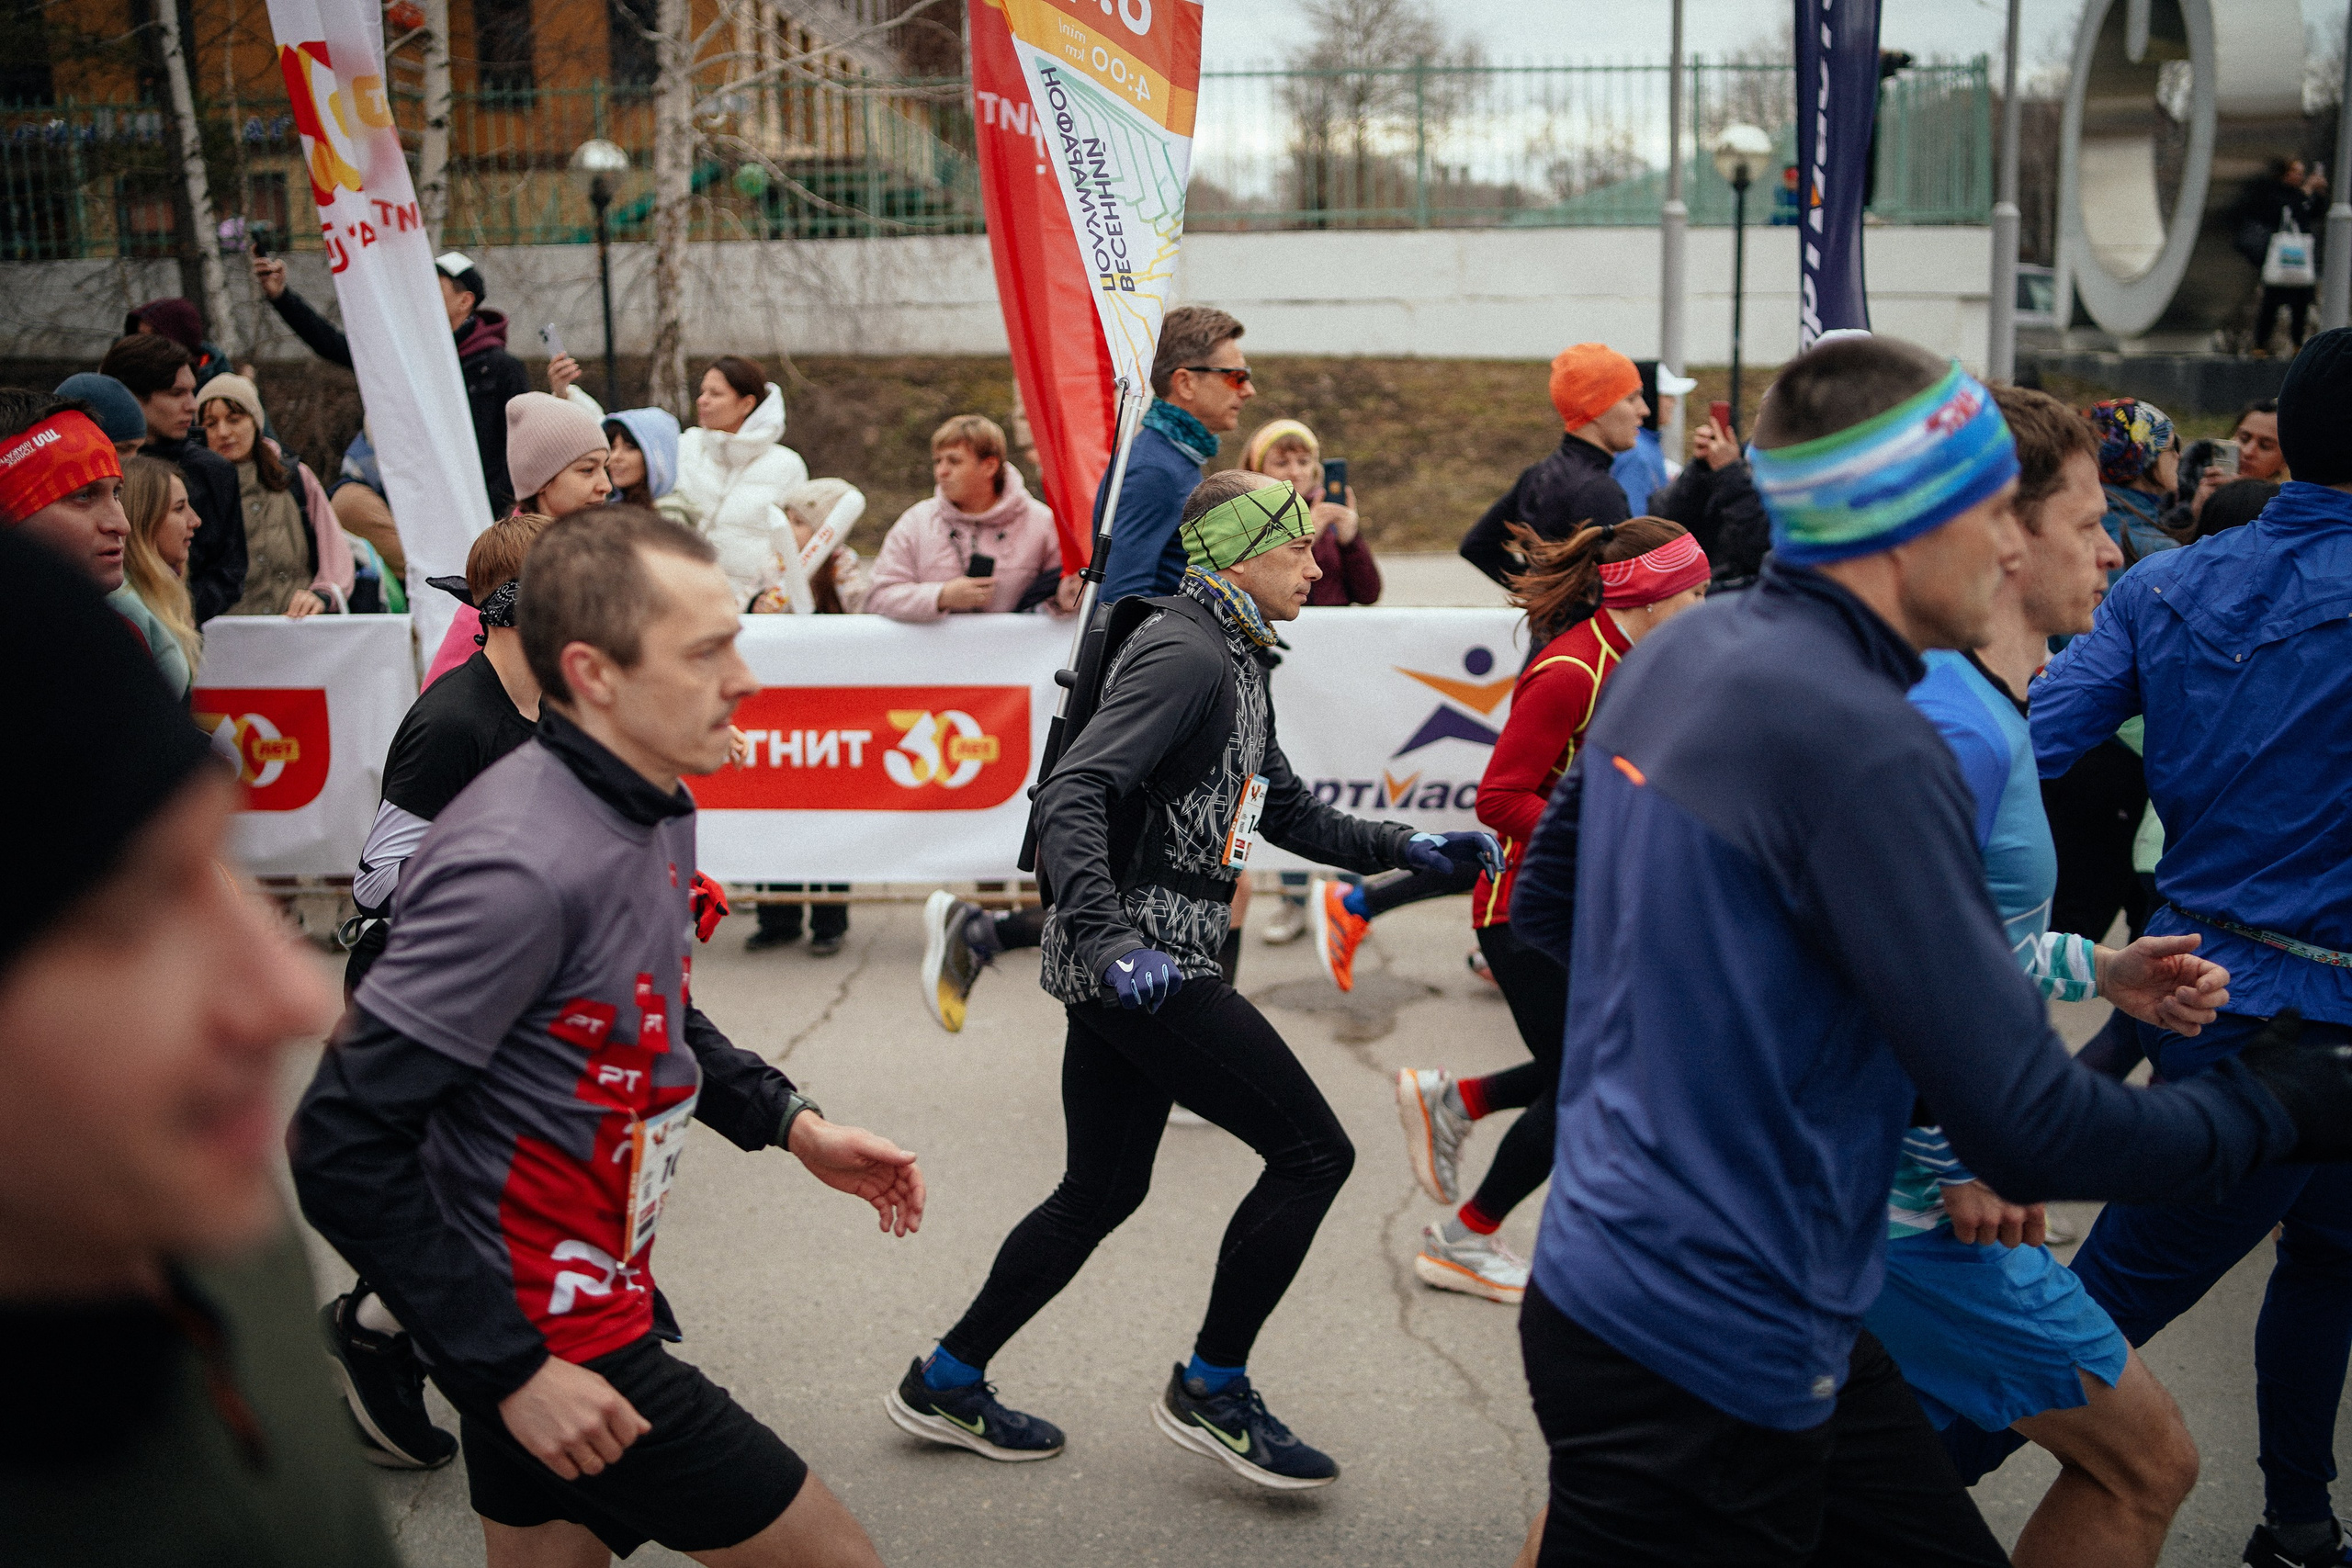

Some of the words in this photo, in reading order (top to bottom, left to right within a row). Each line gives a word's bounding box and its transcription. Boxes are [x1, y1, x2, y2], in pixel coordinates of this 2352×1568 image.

[738, 728, 872, 769] ГНИТ
[883, 709, 981, 789] 30
[597, 1064, 643, 1093] PT
